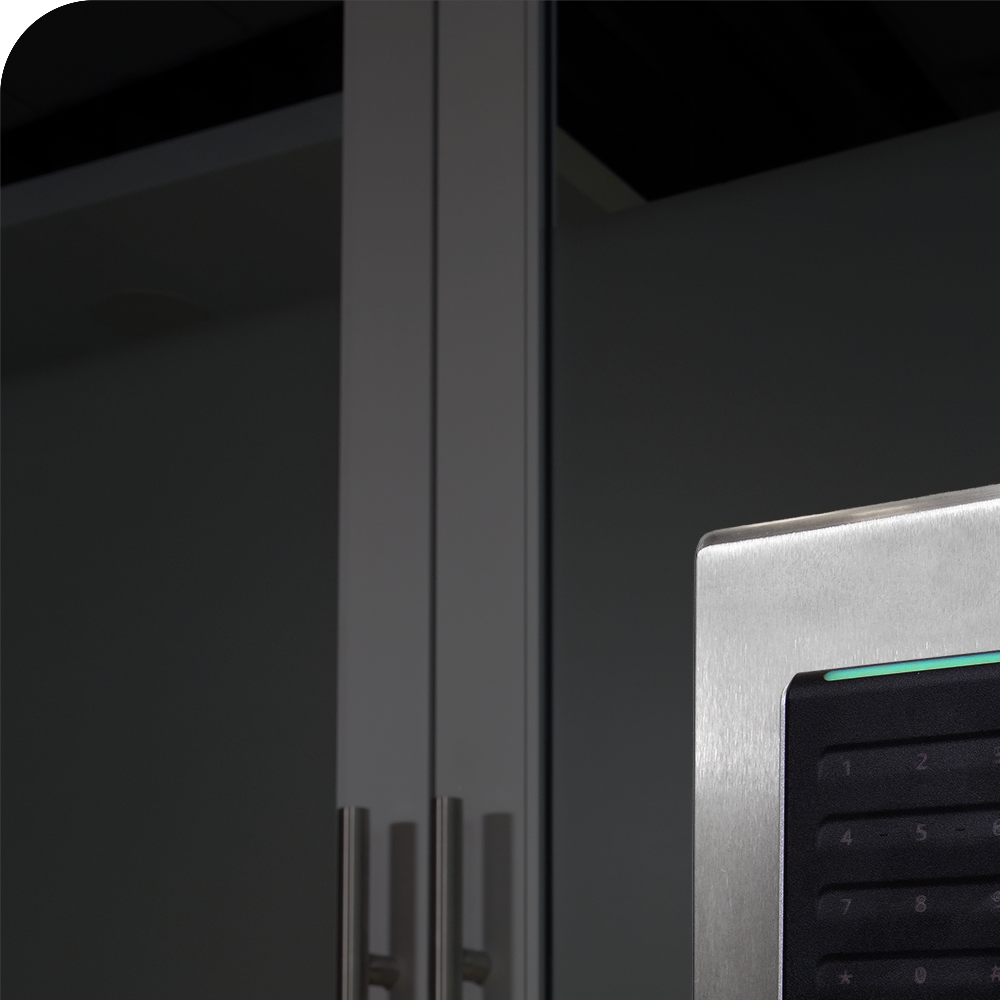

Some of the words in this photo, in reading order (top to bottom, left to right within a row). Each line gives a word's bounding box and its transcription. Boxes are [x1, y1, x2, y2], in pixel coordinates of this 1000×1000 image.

[842, 760, 851, 776] 1
[917, 753, 928, 771] 2
[840, 829, 852, 846] 4
[916, 823, 928, 841] 5
[840, 898, 852, 915] 7
[914, 895, 926, 913] 8
[915, 967, 926, 984] 0
